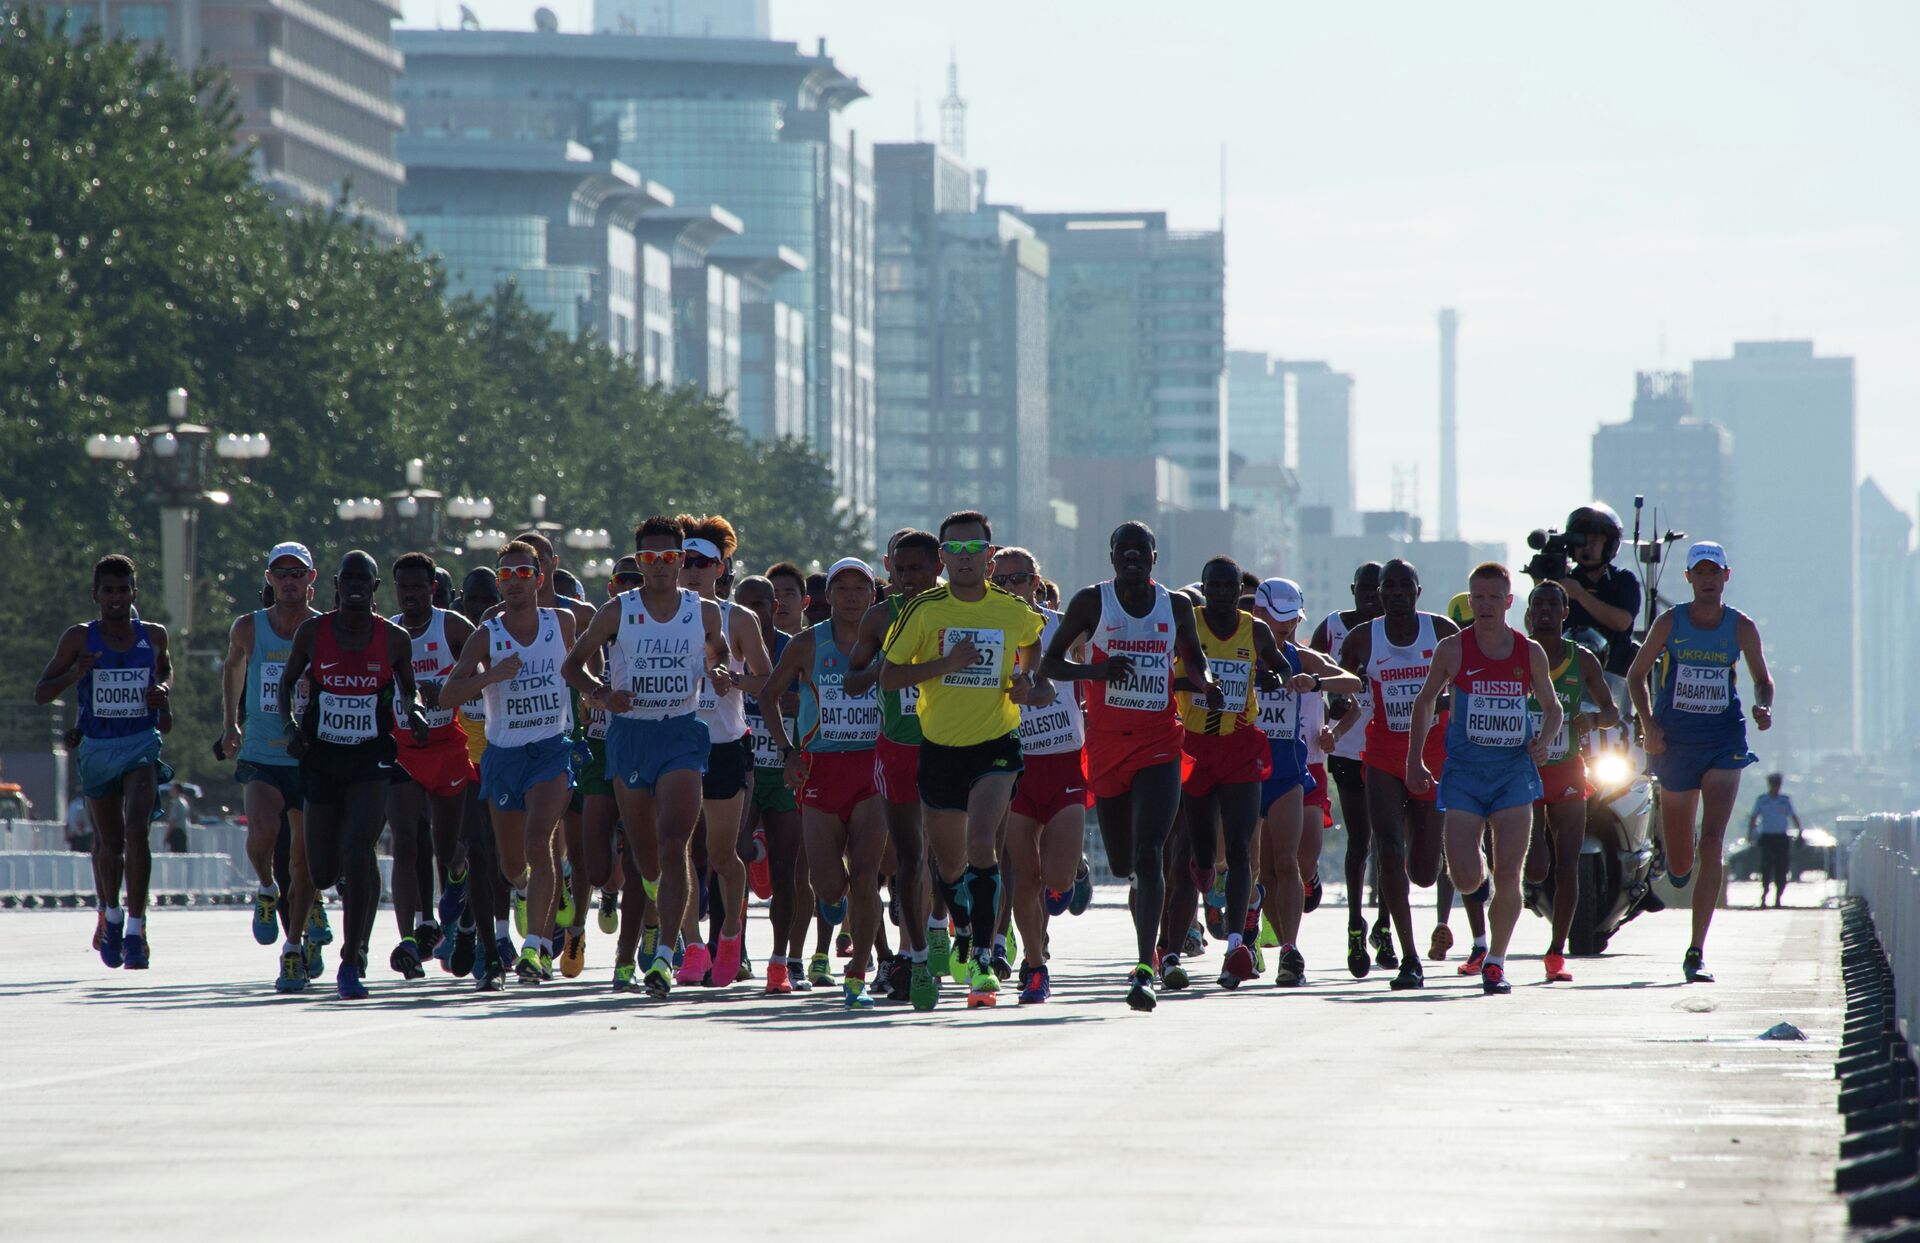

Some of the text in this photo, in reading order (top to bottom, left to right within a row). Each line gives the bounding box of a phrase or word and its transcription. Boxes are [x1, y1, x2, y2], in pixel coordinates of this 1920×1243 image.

[636, 639, 689, 653] ITALIA
[1107, 640, 1168, 654] BAHRAIN
[1127, 653, 1166, 669] TDK
[1678, 649, 1728, 662] UKRAINE
[411, 658, 439, 673] RAIN
[519, 658, 555, 676] ALIA
[647, 656, 686, 669] TDK
[1211, 661, 1247, 675] TDK
[110, 670, 145, 682] TDK
[1692, 668, 1725, 680] TDK
[322, 675, 378, 688] KENYA
[519, 674, 555, 691] TDK
[632, 675, 689, 694] MEUCCI
[944, 675, 999, 687] BEIJING 2015
[1109, 674, 1165, 695] KHAMIS
[1471, 680, 1523, 695] RUSSIA
[1219, 679, 1248, 698] ROTICH
[1397, 683, 1425, 696] TD
[1676, 681, 1727, 701] BABARYNKA
[96, 687, 146, 704] COORAY
[334, 697, 372, 710] TDK
[507, 692, 560, 716] PERTILE
[632, 698, 667, 708] BEIJING
[1108, 695, 1166, 710] BEIJING 2015
[1485, 697, 1522, 710] TDK
[1675, 701, 1706, 713] BEIJING
[96, 707, 128, 718] BEIJING
[821, 707, 879, 725] BAT-OCHIR
[322, 710, 372, 731] KORIR
[433, 716, 450, 727] 2015
[508, 717, 542, 730] BEIJING
[1018, 710, 1071, 738] GGLESTON
[1468, 713, 1524, 732] REUNKOV
[320, 731, 353, 744] BEIJING
[824, 730, 877, 740] BEIJING 2015
[1053, 732, 1073, 745] 2015
[1275, 729, 1293, 739] 2015
[1470, 735, 1522, 746] BEIJING 2015
